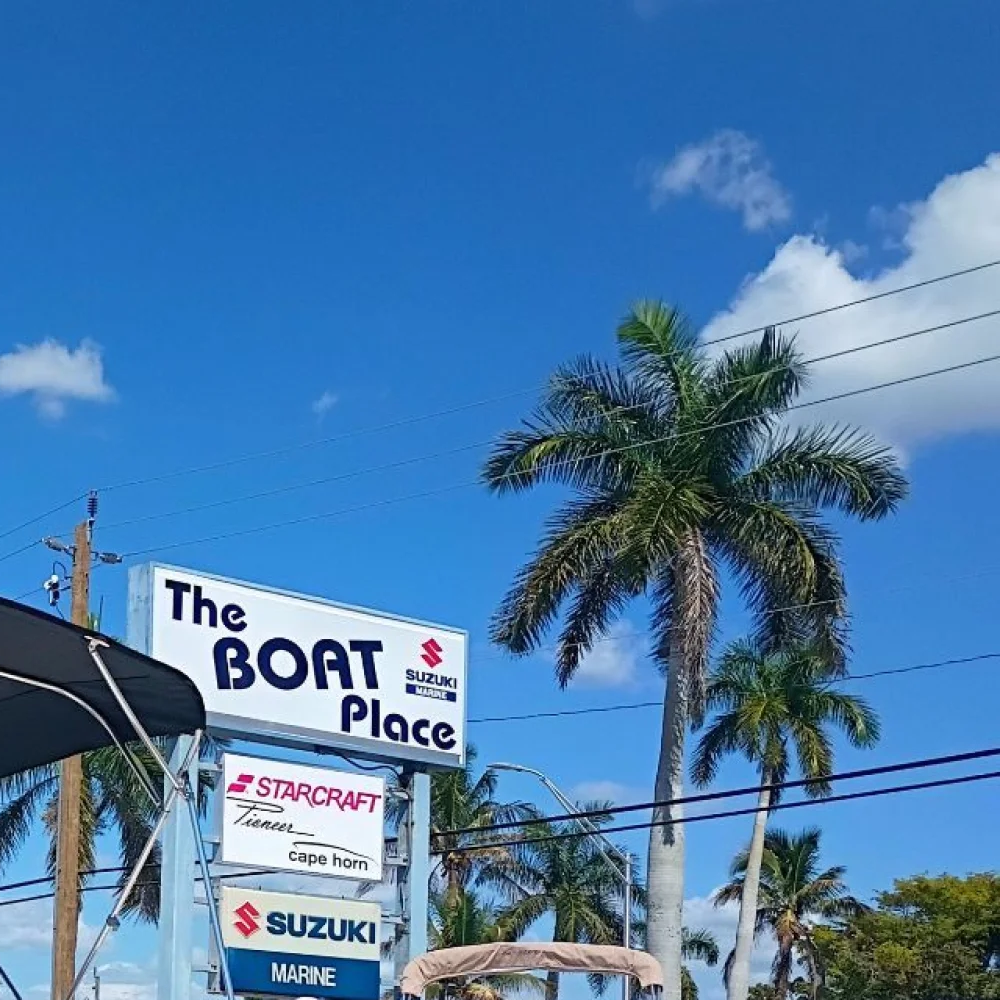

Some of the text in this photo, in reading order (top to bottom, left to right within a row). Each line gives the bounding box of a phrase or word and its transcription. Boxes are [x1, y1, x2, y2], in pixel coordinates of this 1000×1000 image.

[165, 579, 247, 632] The
[213, 637, 383, 690] BOAT
[406, 669, 457, 689] SUZUKI
[341, 694, 457, 750] Place
[256, 777, 382, 813] STARCRAFT
[288, 850, 368, 871] cape horn
[266, 911, 376, 945] SUZUKI
[271, 962, 337, 987] MARINE
